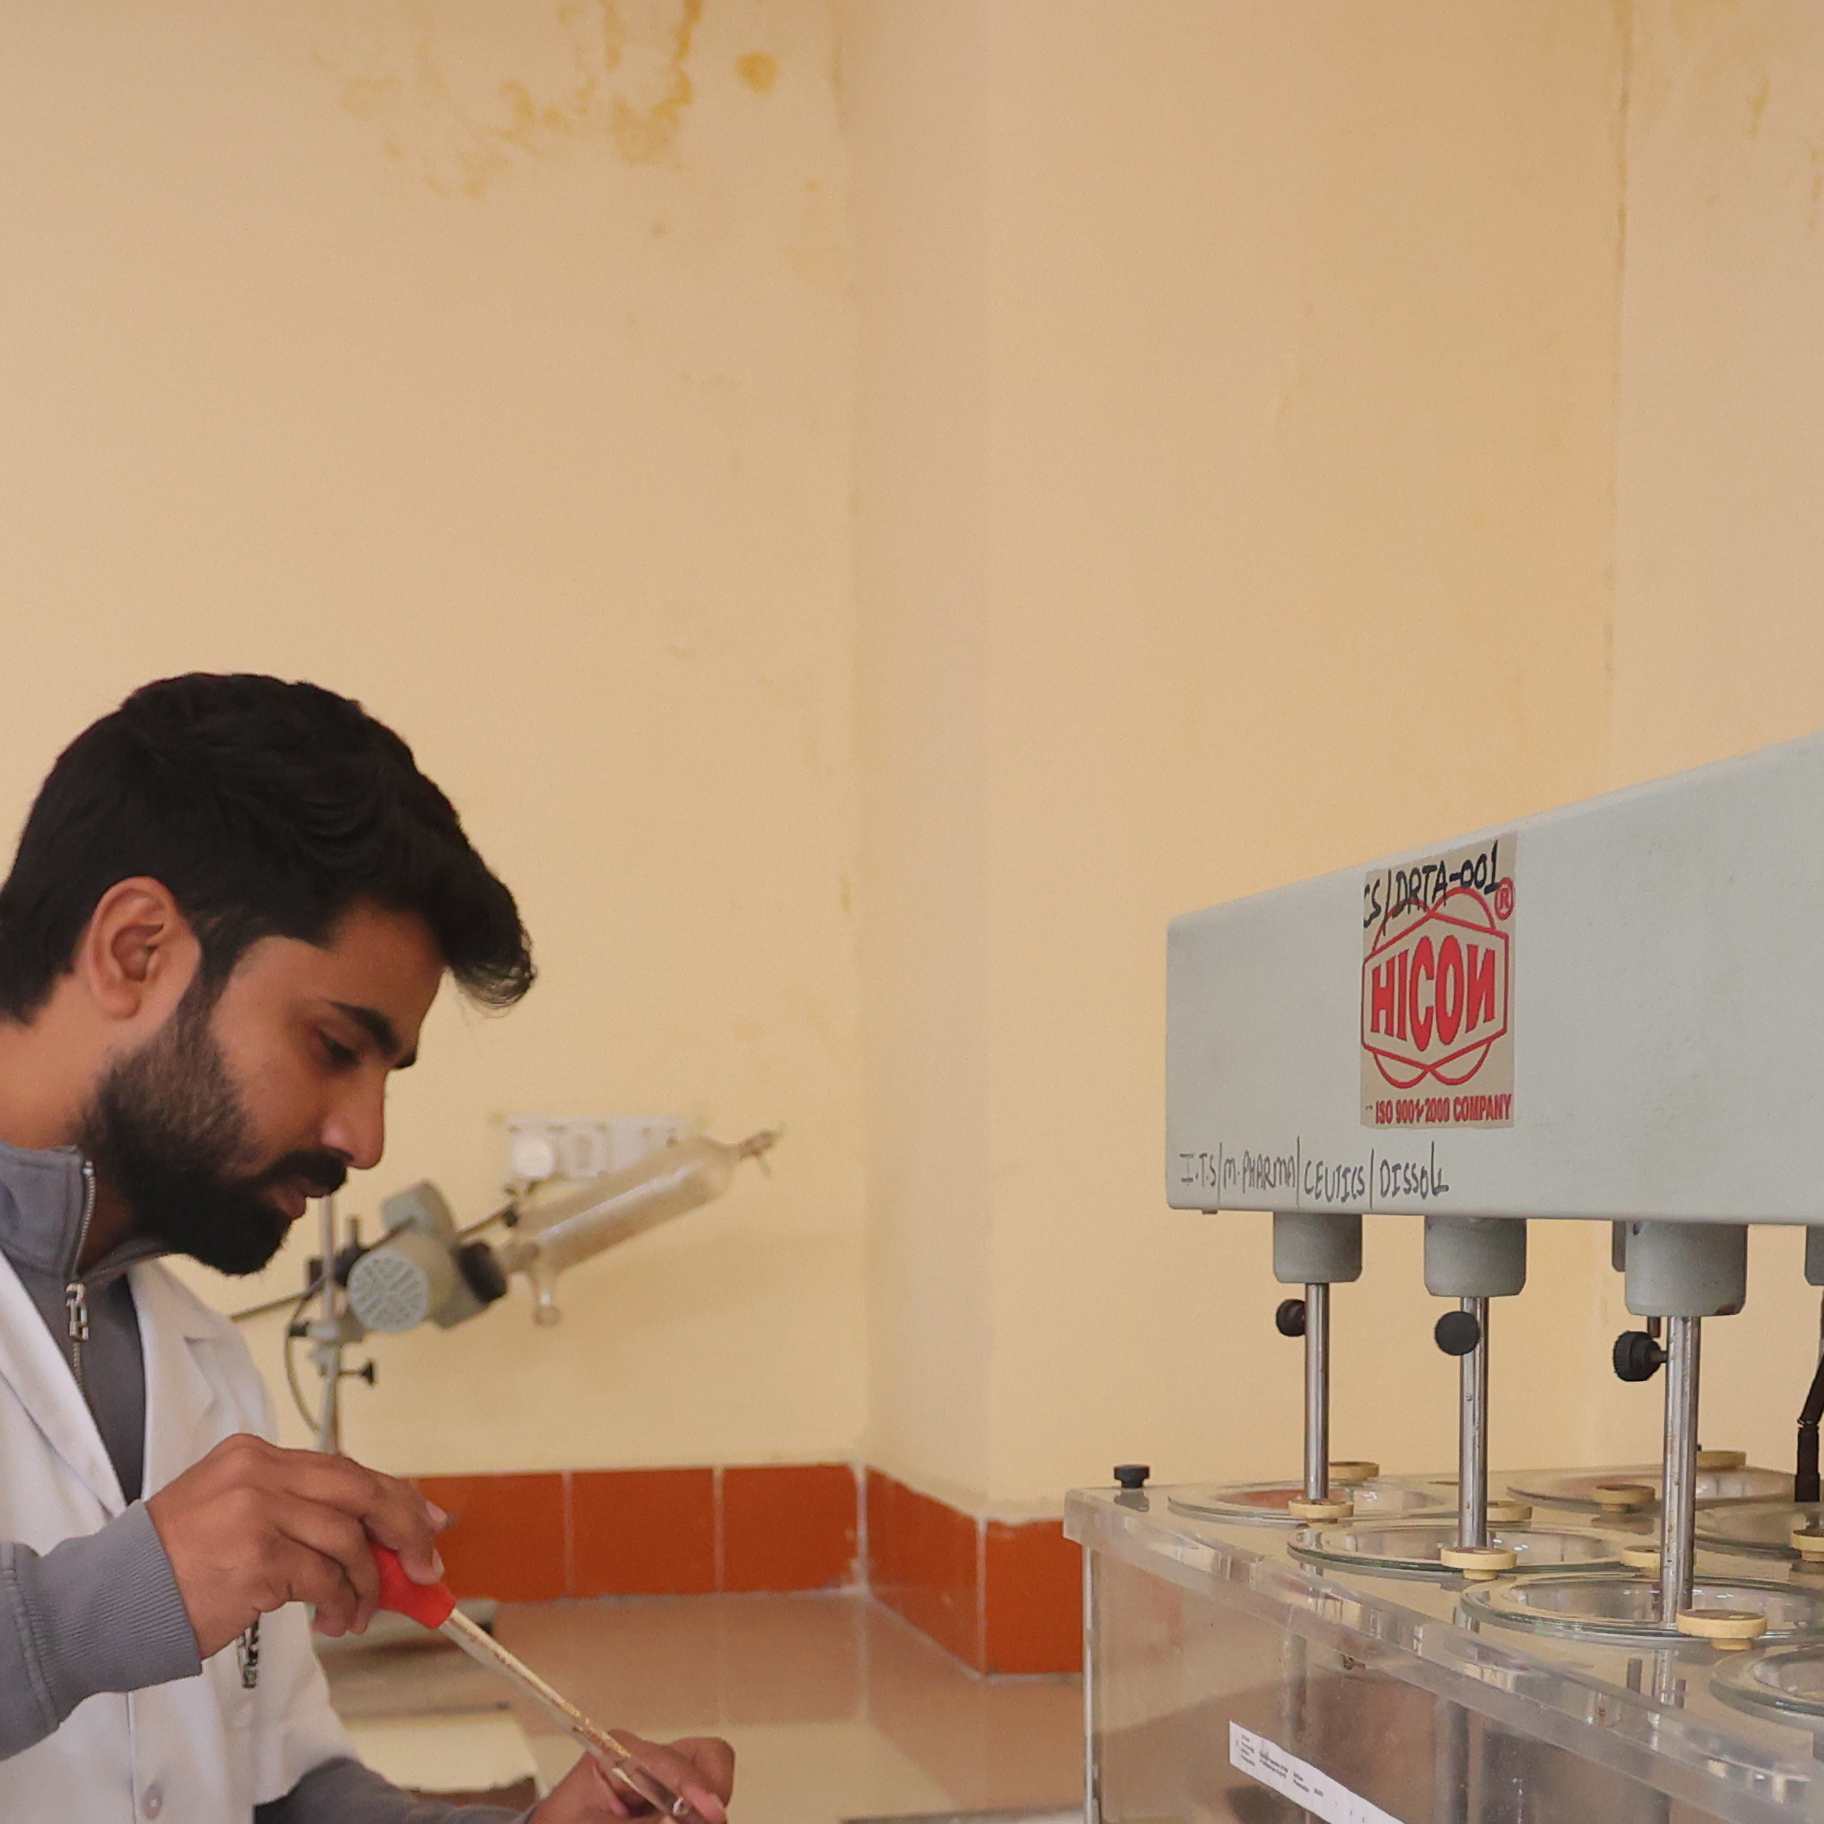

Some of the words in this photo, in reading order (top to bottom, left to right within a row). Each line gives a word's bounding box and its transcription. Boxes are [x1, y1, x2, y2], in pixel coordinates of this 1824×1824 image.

[1370, 934, 1496, 1052] HICON
[1375, 1099, 1394, 1125] ISO
[1453, 1093, 1513, 1123] COMPANY
